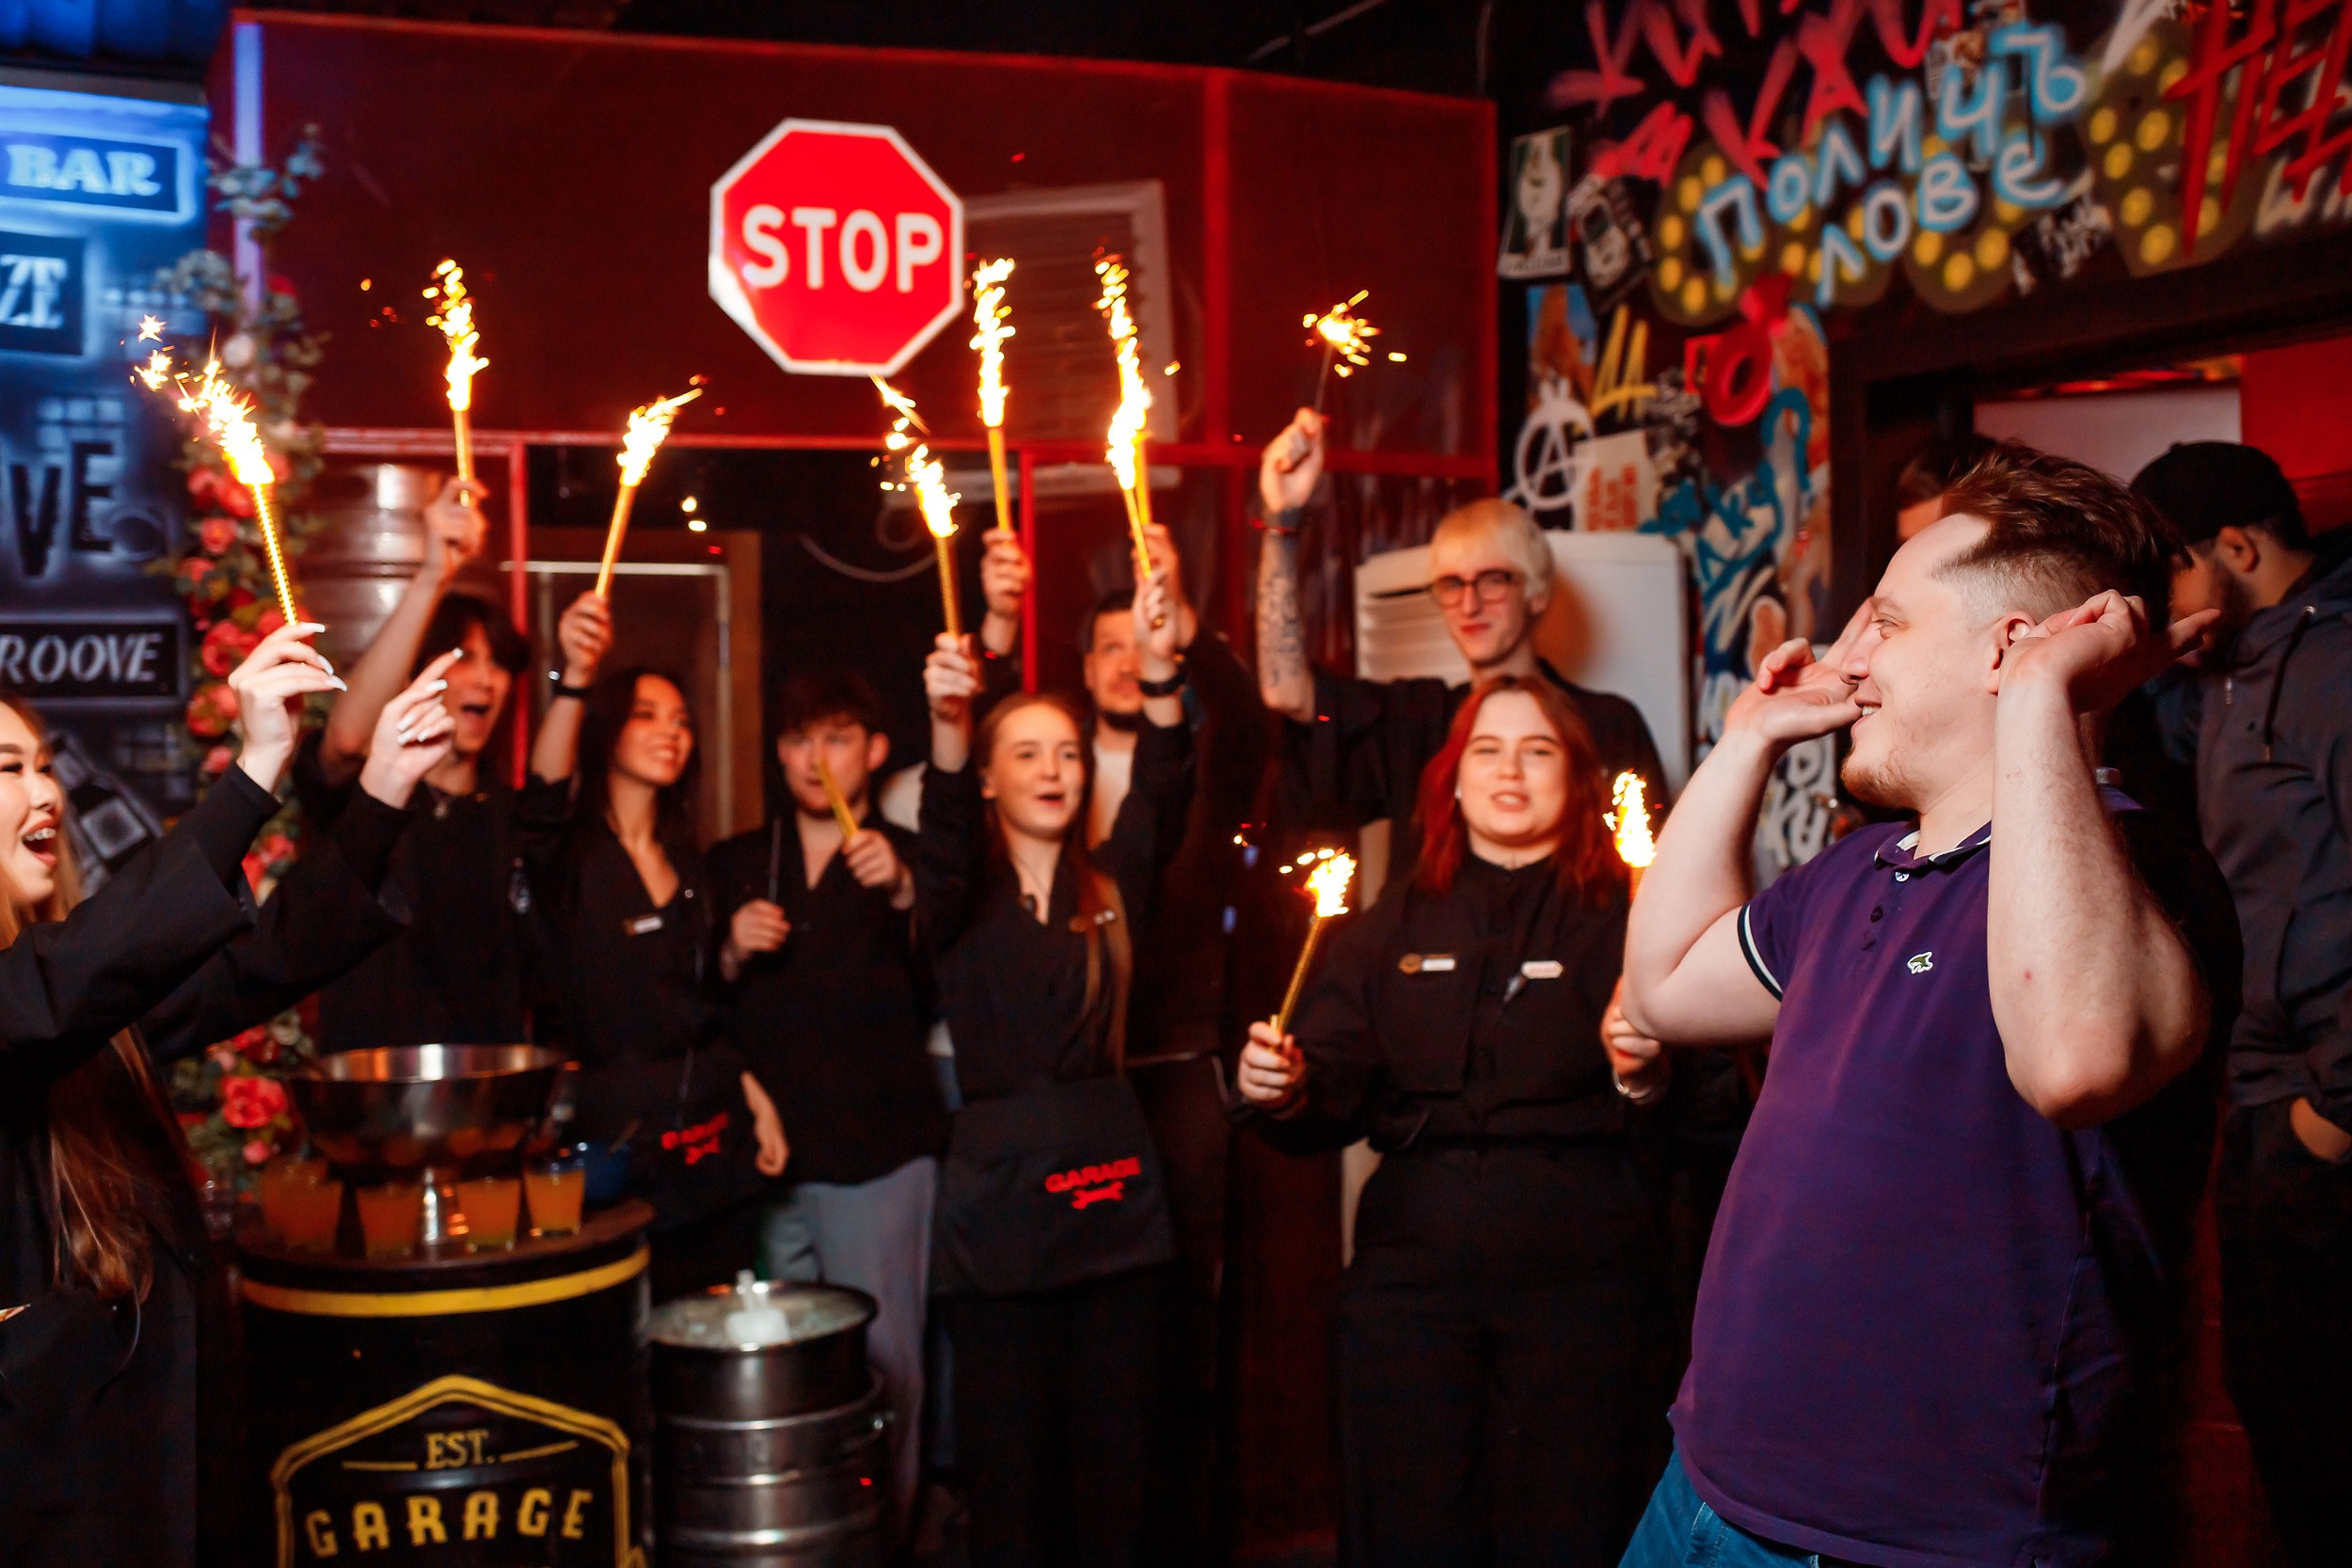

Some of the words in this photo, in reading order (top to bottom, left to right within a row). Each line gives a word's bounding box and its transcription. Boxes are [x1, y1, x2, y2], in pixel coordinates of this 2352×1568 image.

[7, 144, 161, 197] BAR
[741, 203, 944, 293] STOP
[424, 1429, 498, 1470] EST.
[304, 1487, 595, 1558] GARAGE
